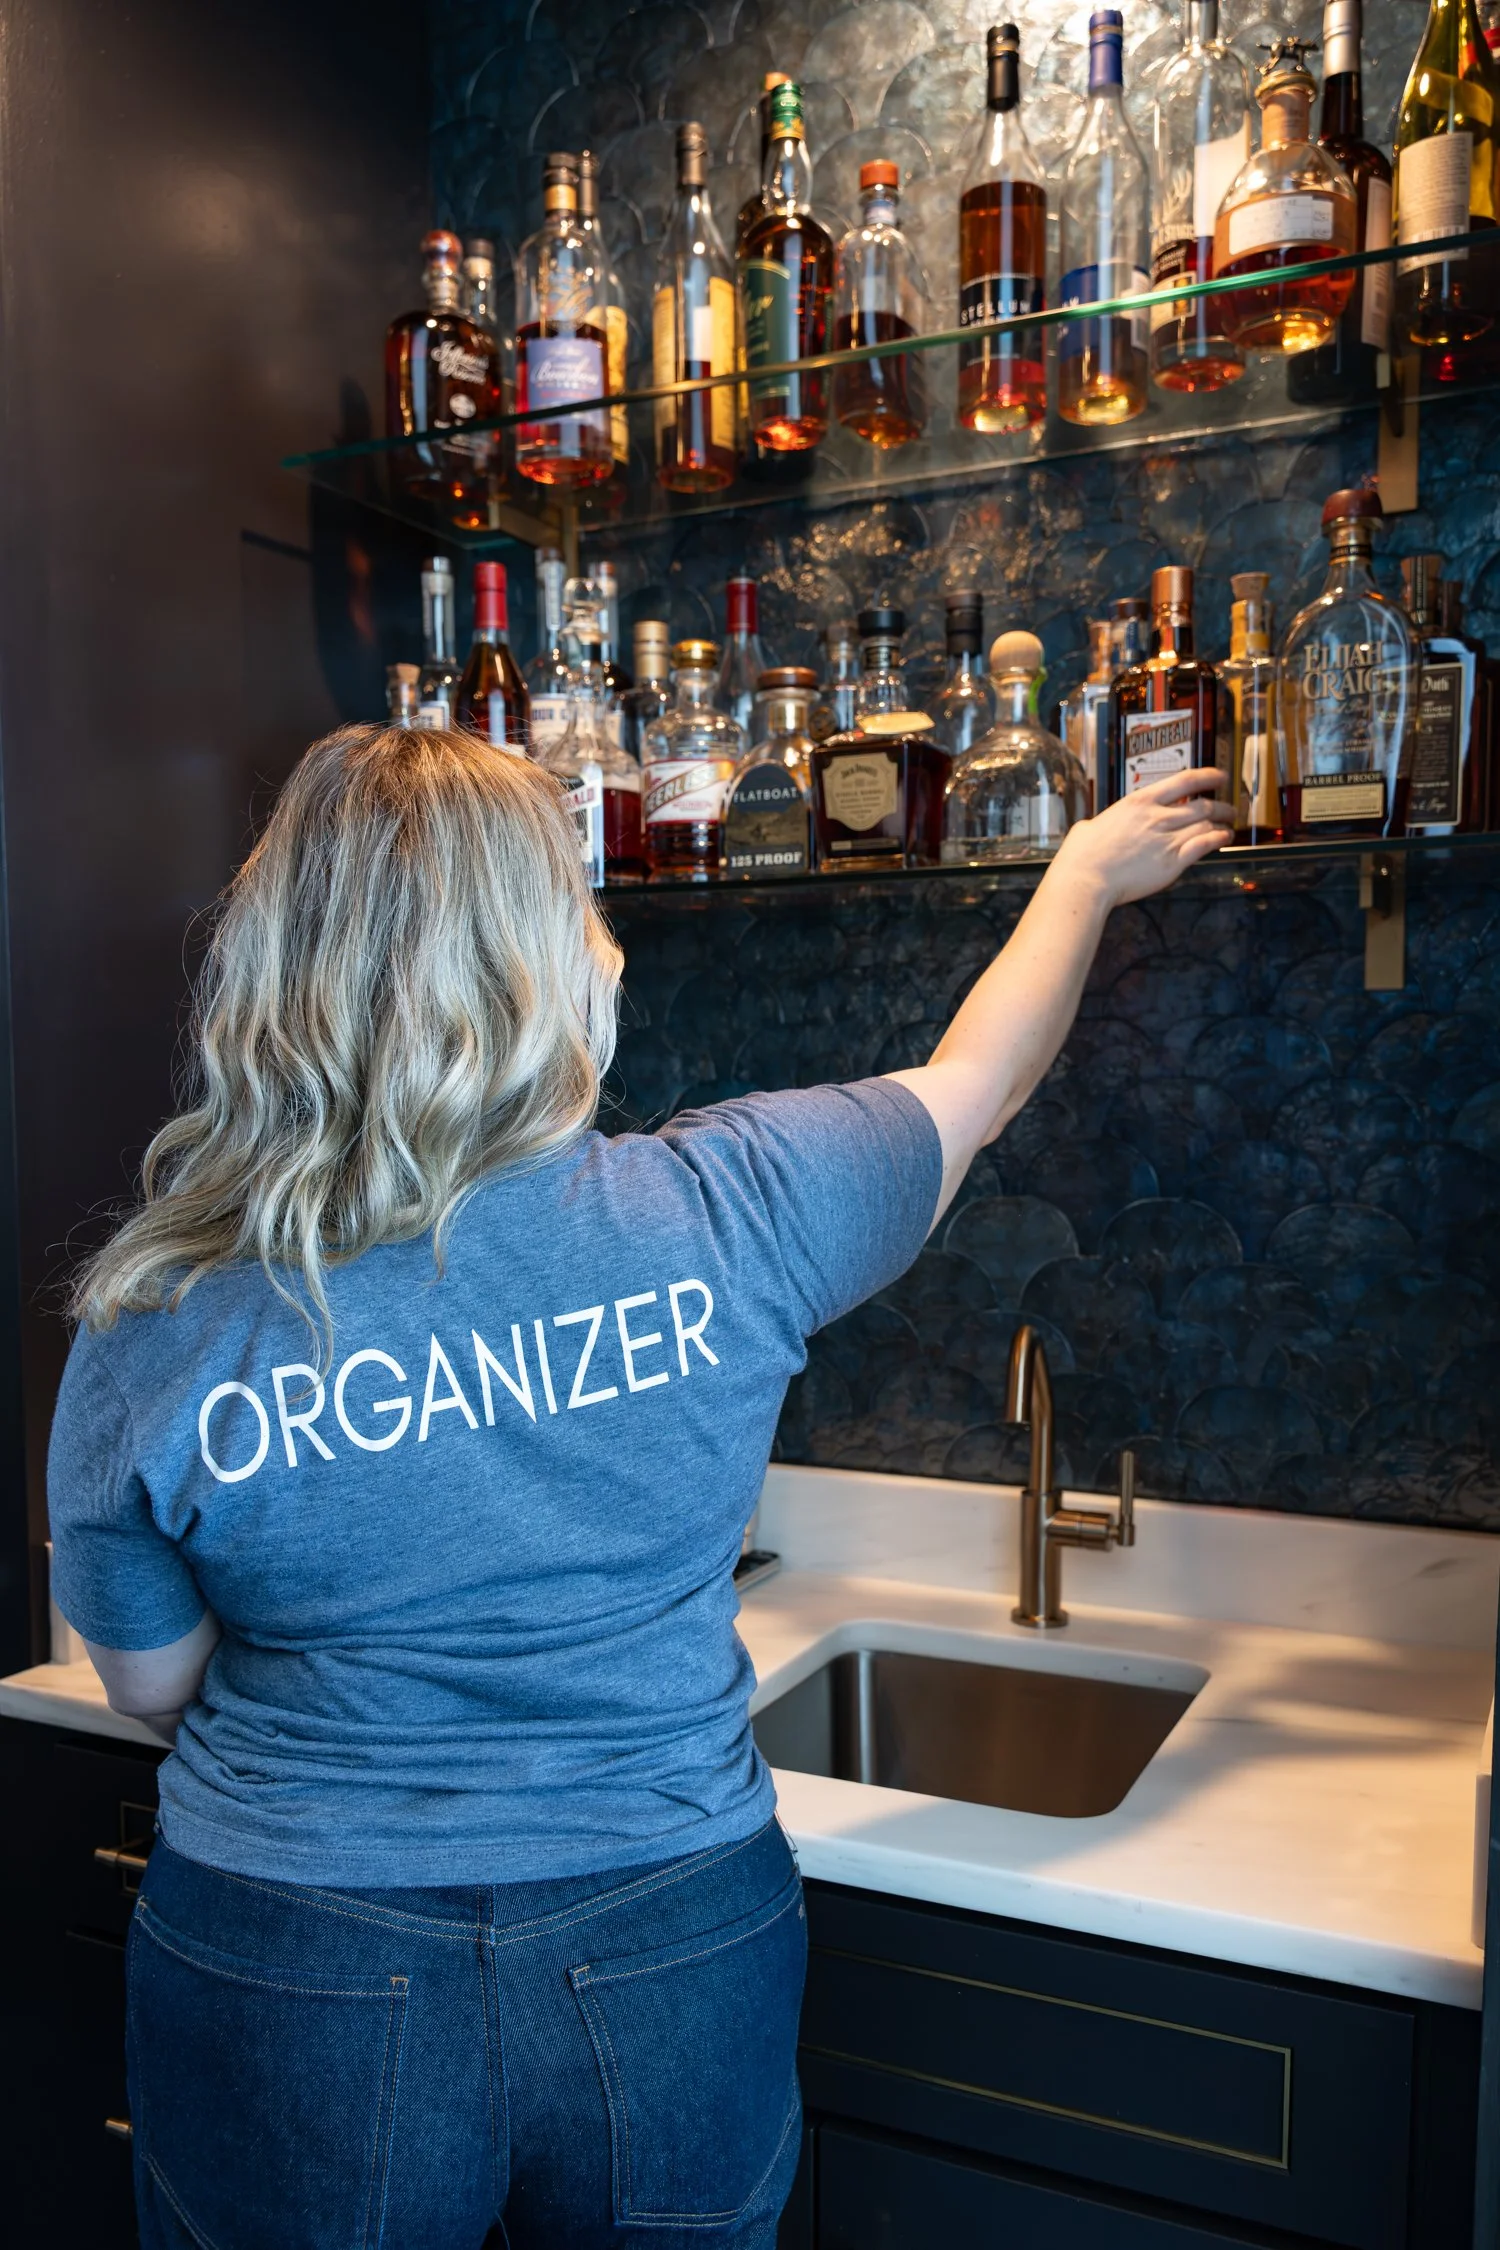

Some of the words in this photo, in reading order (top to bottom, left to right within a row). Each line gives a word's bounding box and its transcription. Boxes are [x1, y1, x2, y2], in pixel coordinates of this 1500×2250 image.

[1303, 640, 1384, 672] ELIJAH
[1303, 667, 1383, 700] CRAIG
[1304, 775, 1345, 787] BARREL
[1347, 772, 1381, 784] PROOF
[733, 786, 798, 803] FLATBOAT
[730, 855, 753, 868] 125
[755, 851, 803, 866] PROOF
[198, 1279, 720, 1482] ORGANIZER
